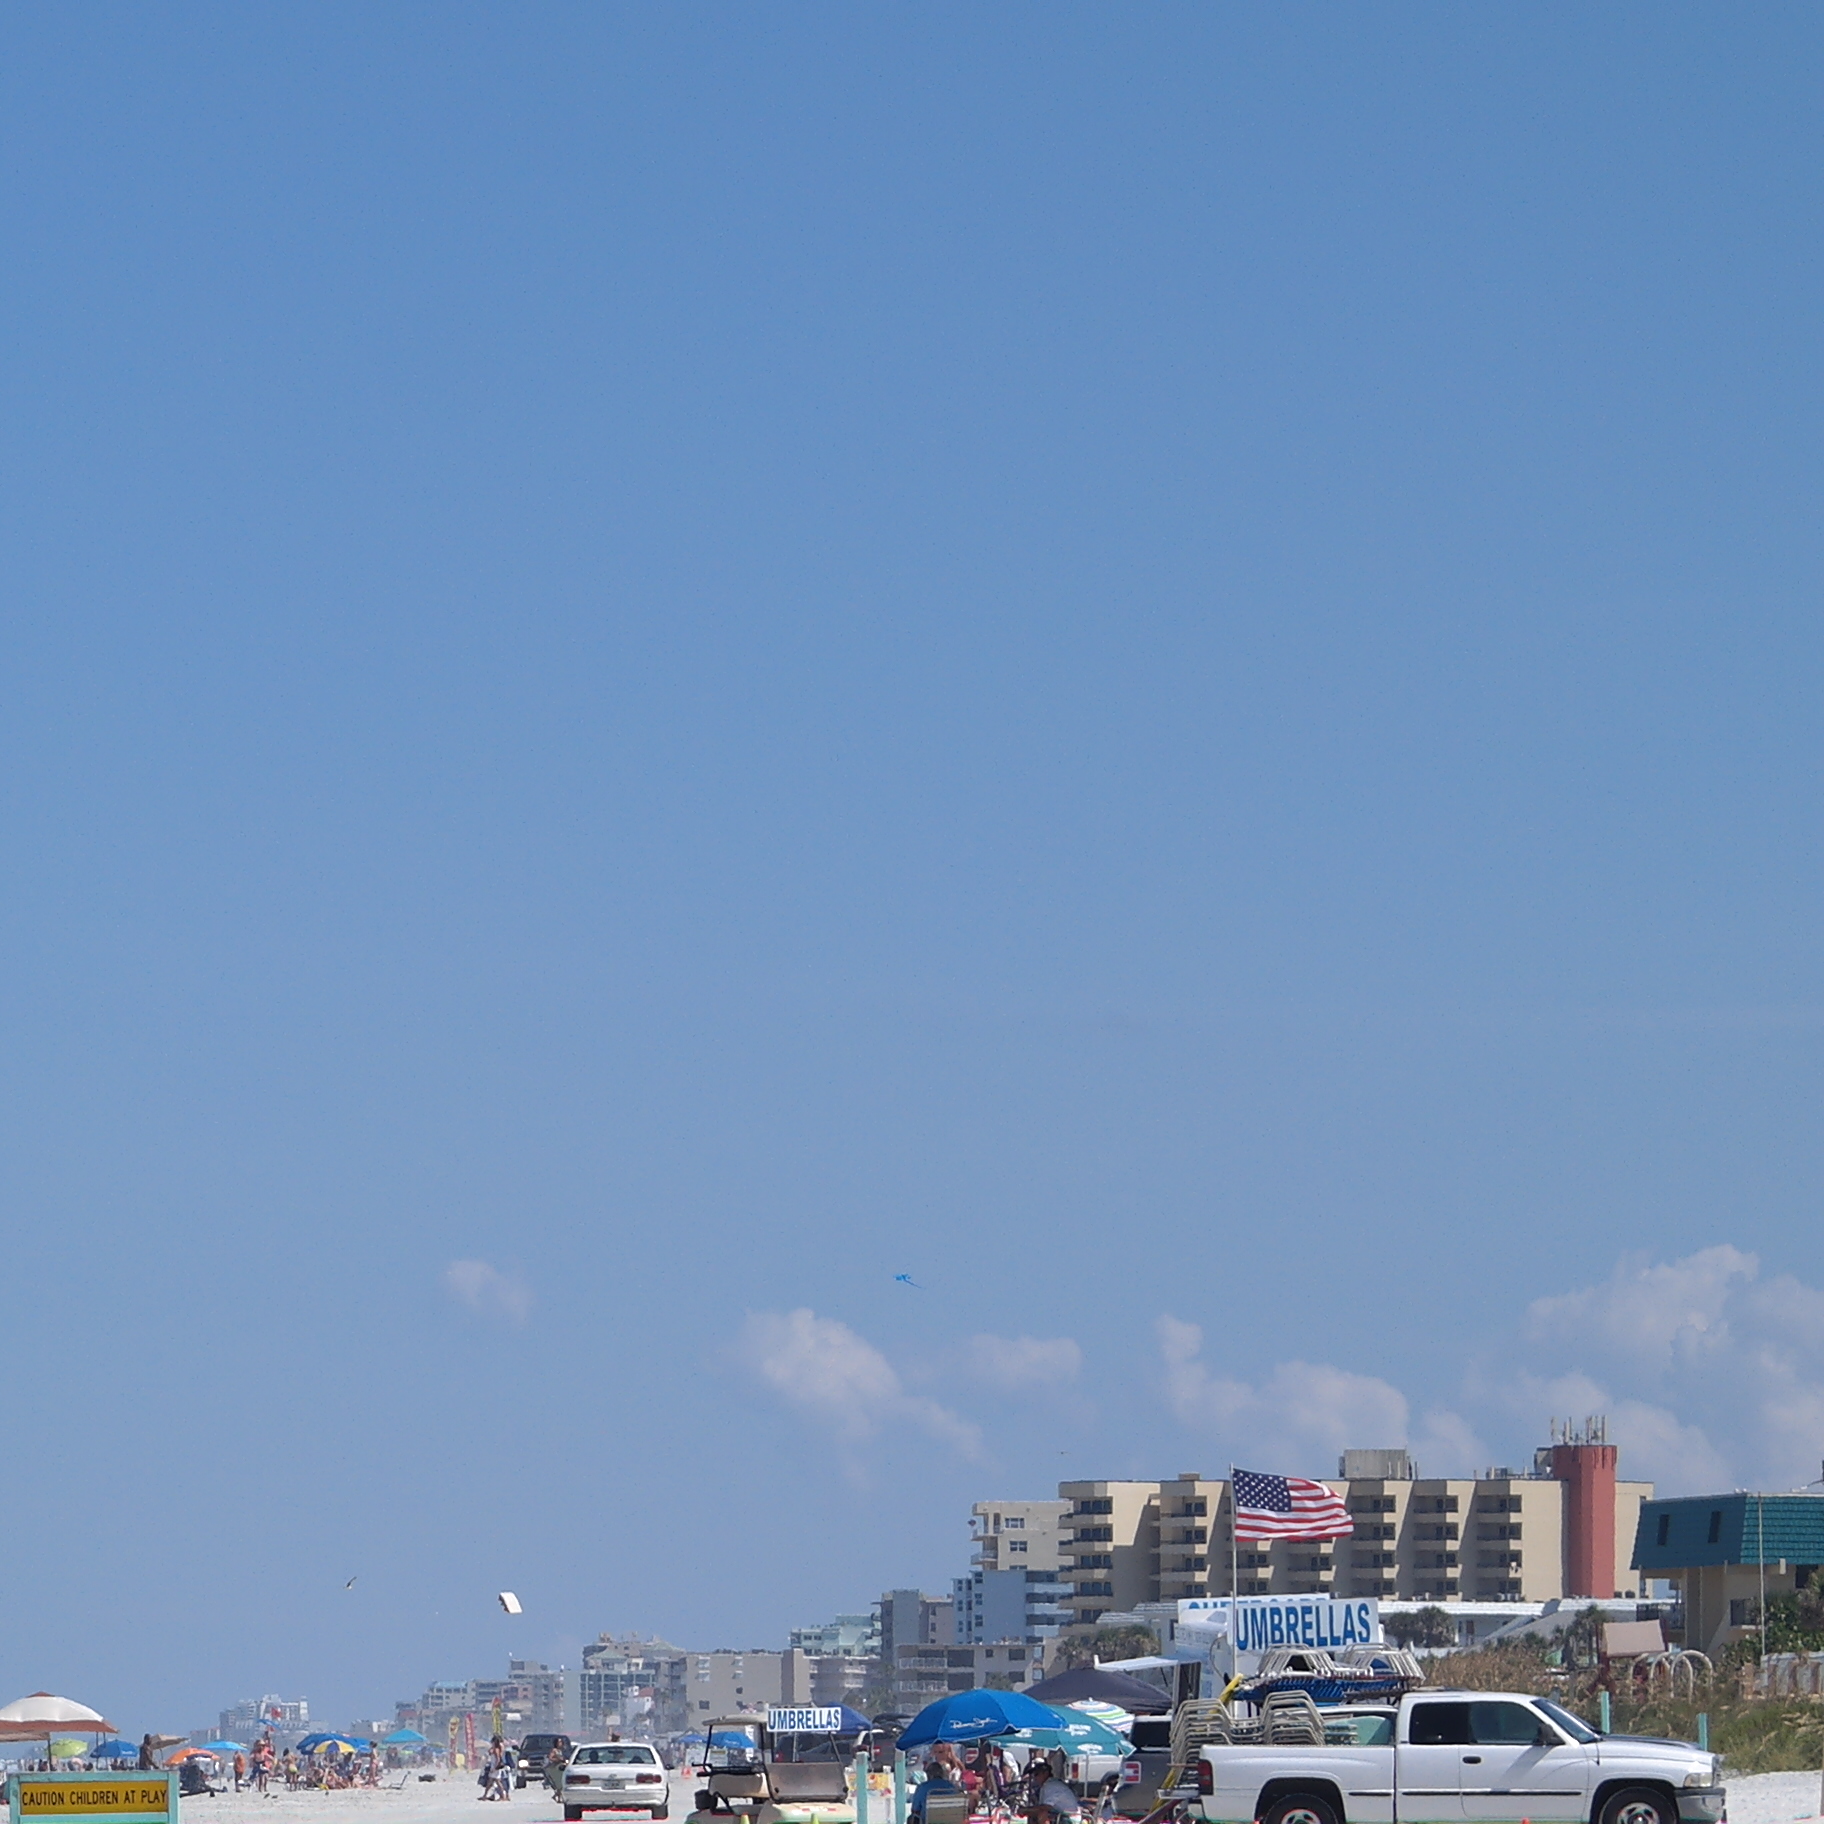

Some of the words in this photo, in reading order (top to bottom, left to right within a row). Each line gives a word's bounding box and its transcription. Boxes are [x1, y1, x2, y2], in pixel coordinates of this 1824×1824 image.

[1236, 1602, 1372, 1651] UMBRELLAS
[768, 1709, 840, 1730] UMBRELLAS
[22, 1791, 64, 1806] CAUTION
[69, 1790, 119, 1805] CHILDREN
[124, 1790, 136, 1804] AT
[141, 1789, 167, 1804] PLAY
